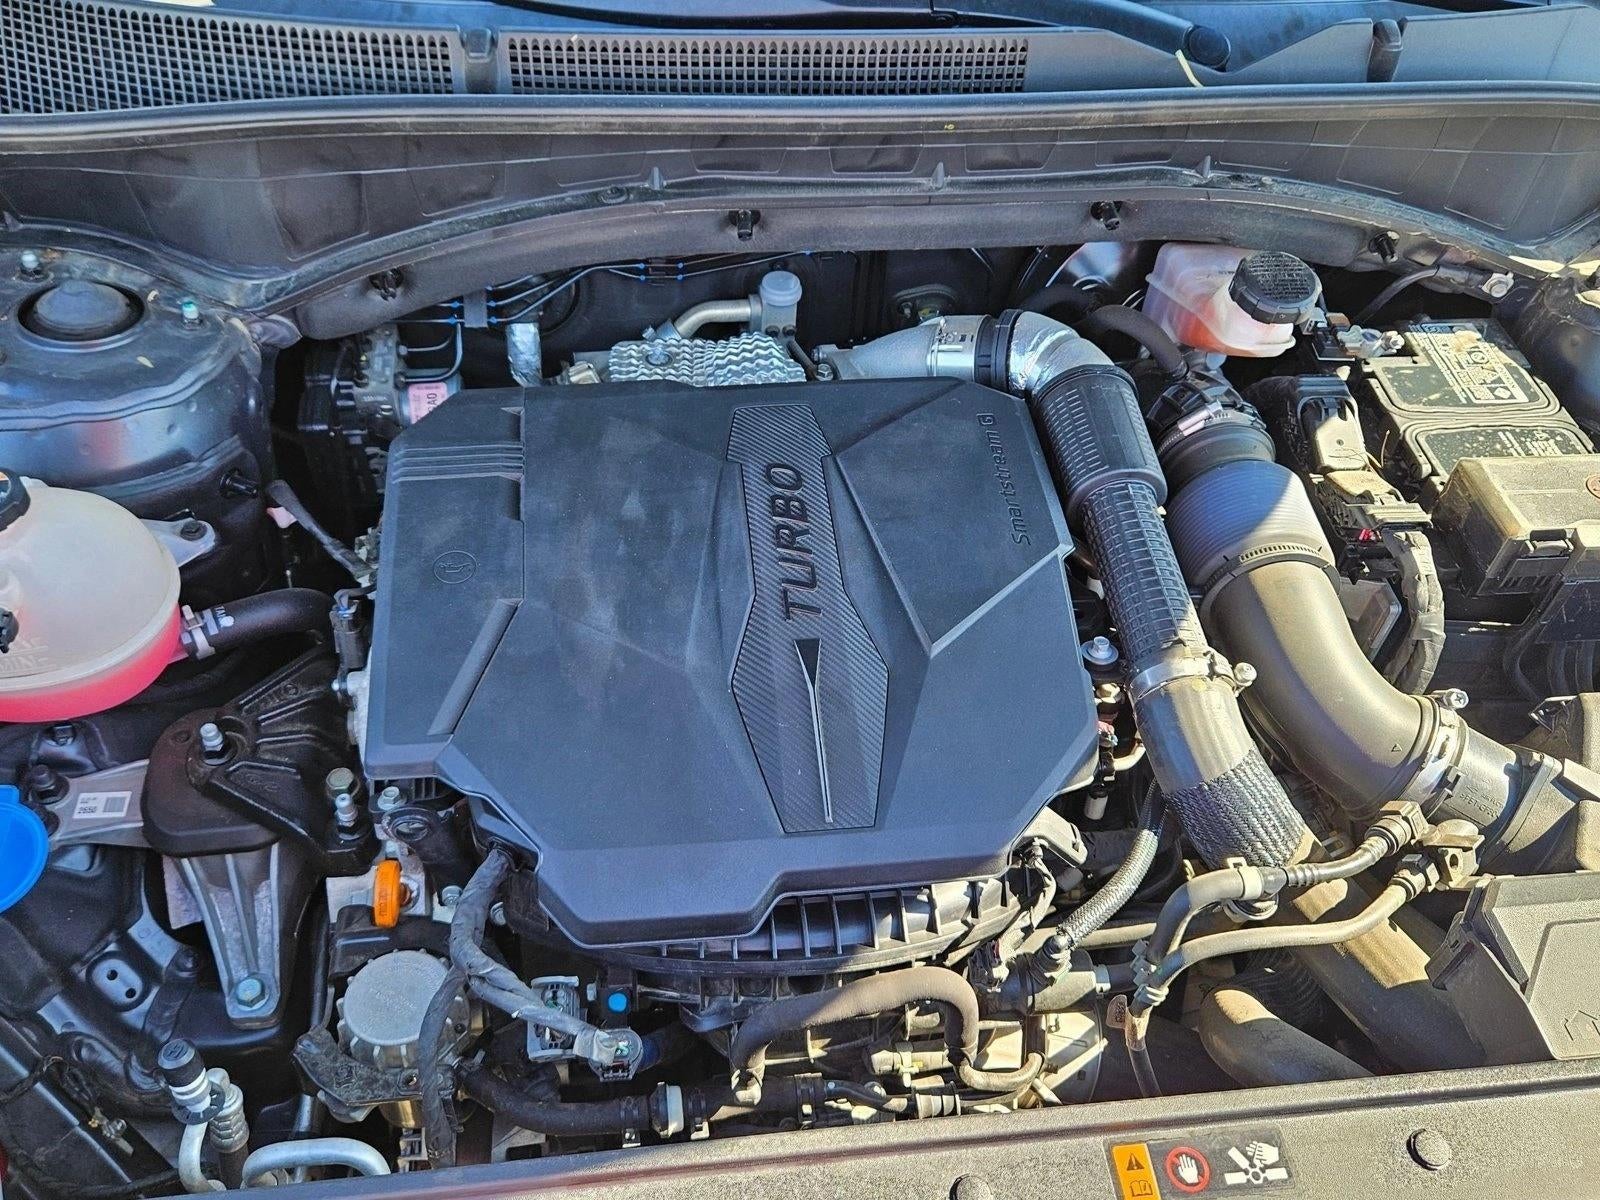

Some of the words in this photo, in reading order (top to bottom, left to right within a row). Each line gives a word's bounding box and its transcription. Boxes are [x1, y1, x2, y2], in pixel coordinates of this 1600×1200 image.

[976, 412, 996, 427] G
[764, 462, 822, 622] TURBO
[985, 430, 1031, 546] Smartstream
